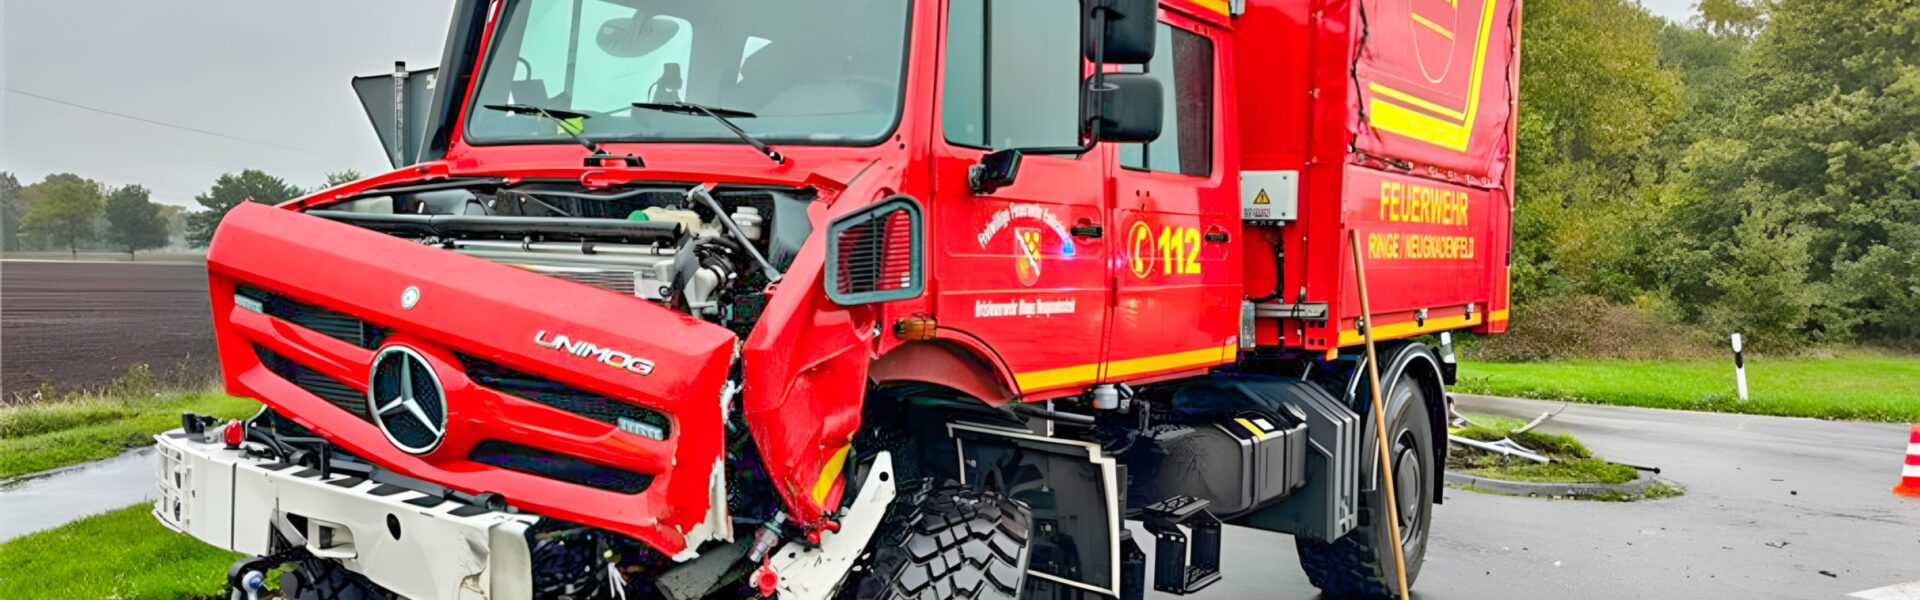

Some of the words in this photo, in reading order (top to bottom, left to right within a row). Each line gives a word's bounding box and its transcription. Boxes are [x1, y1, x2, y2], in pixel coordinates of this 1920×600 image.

[1381, 181, 1468, 226] FEUERWEHR
[1158, 226, 1201, 275] 112
[1368, 232, 1399, 260] RINGE
[534, 329, 655, 376] UNIMOG
